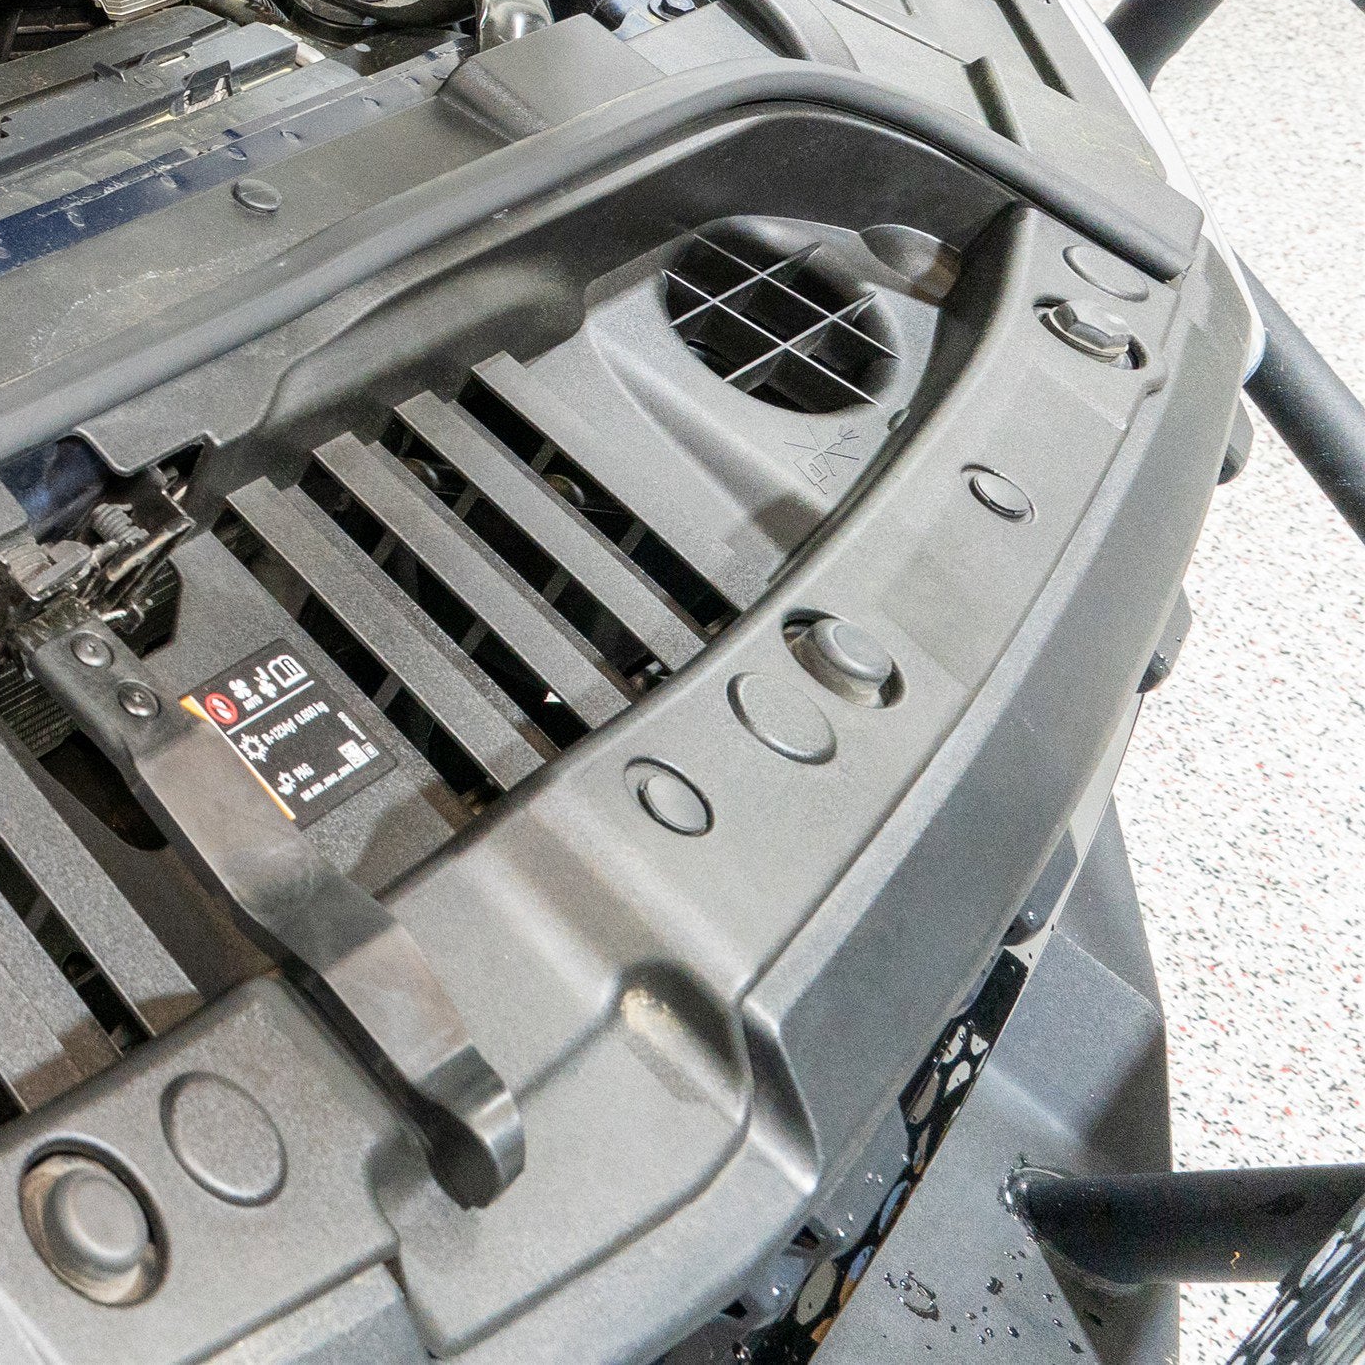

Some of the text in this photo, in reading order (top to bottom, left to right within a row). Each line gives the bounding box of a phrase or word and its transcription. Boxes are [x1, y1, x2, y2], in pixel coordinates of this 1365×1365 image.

[242, 694, 263, 711] AUTO
[261, 718, 298, 746] R-1234yf
[312, 701, 330, 714] kg
[292, 762, 315, 782] PAG
